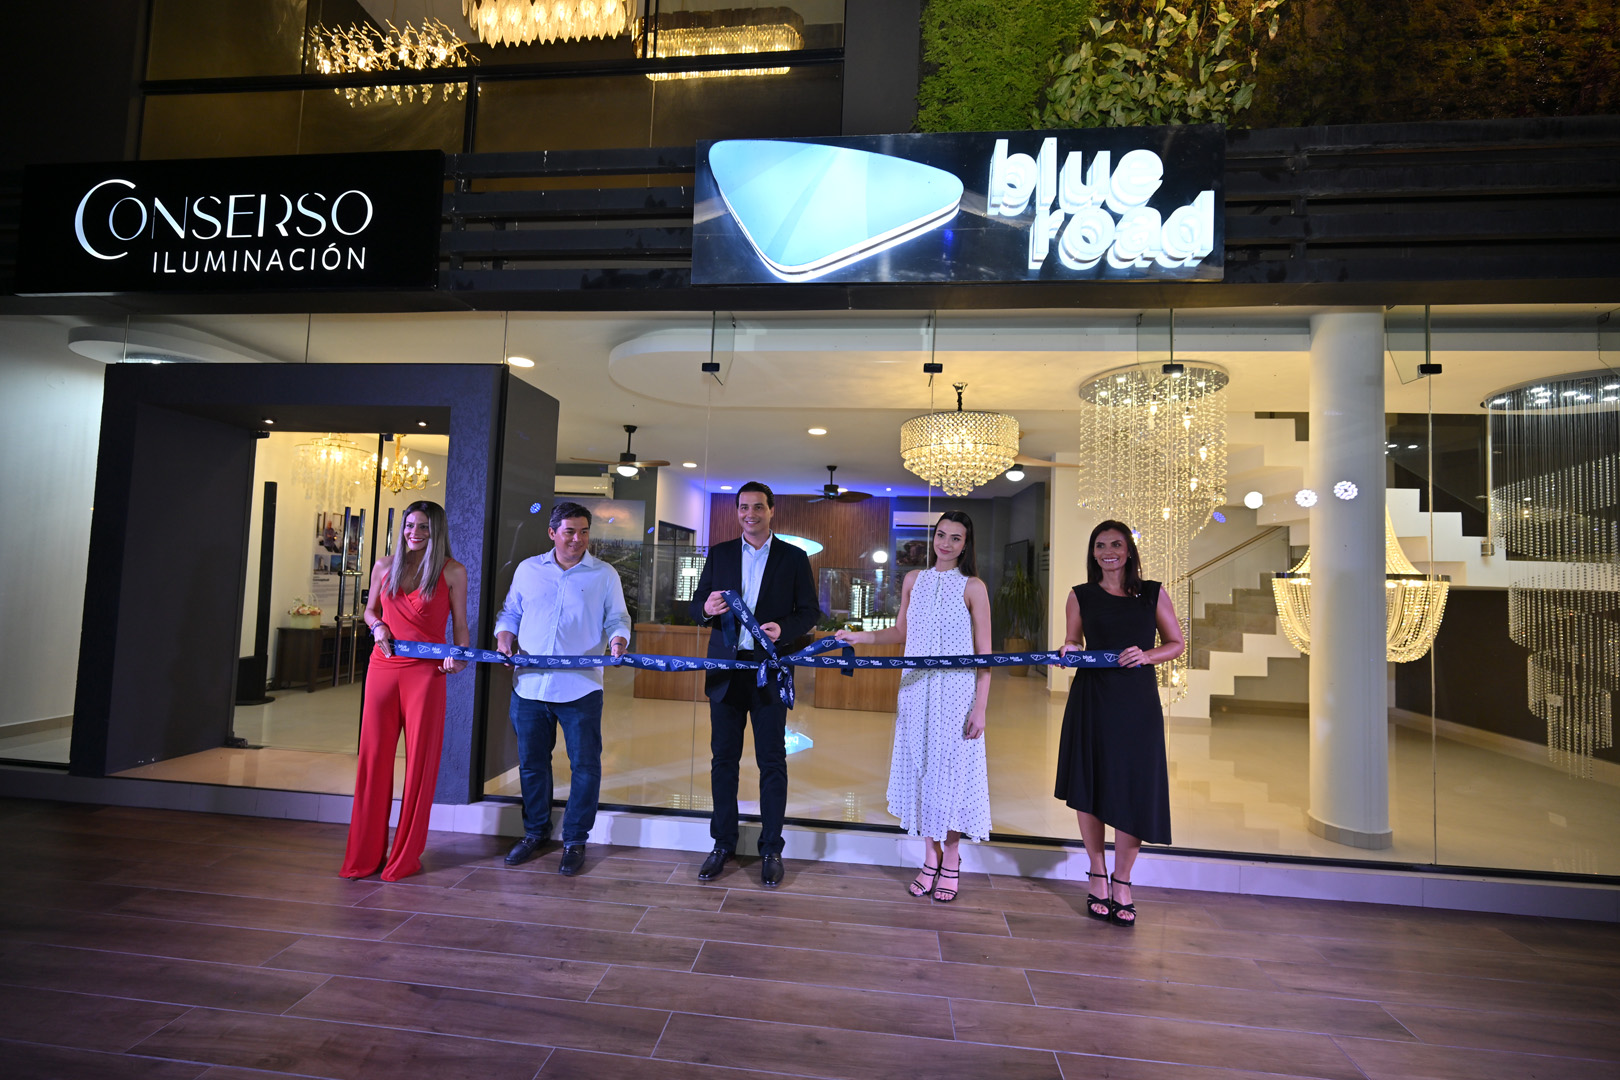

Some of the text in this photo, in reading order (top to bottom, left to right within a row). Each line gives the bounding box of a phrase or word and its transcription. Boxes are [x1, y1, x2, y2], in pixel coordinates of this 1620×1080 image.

[986, 137, 1164, 216] blue
[74, 178, 373, 260] CONSERSO
[152, 243, 366, 273] ILUMINACIÓN
[1028, 190, 1215, 271] road
